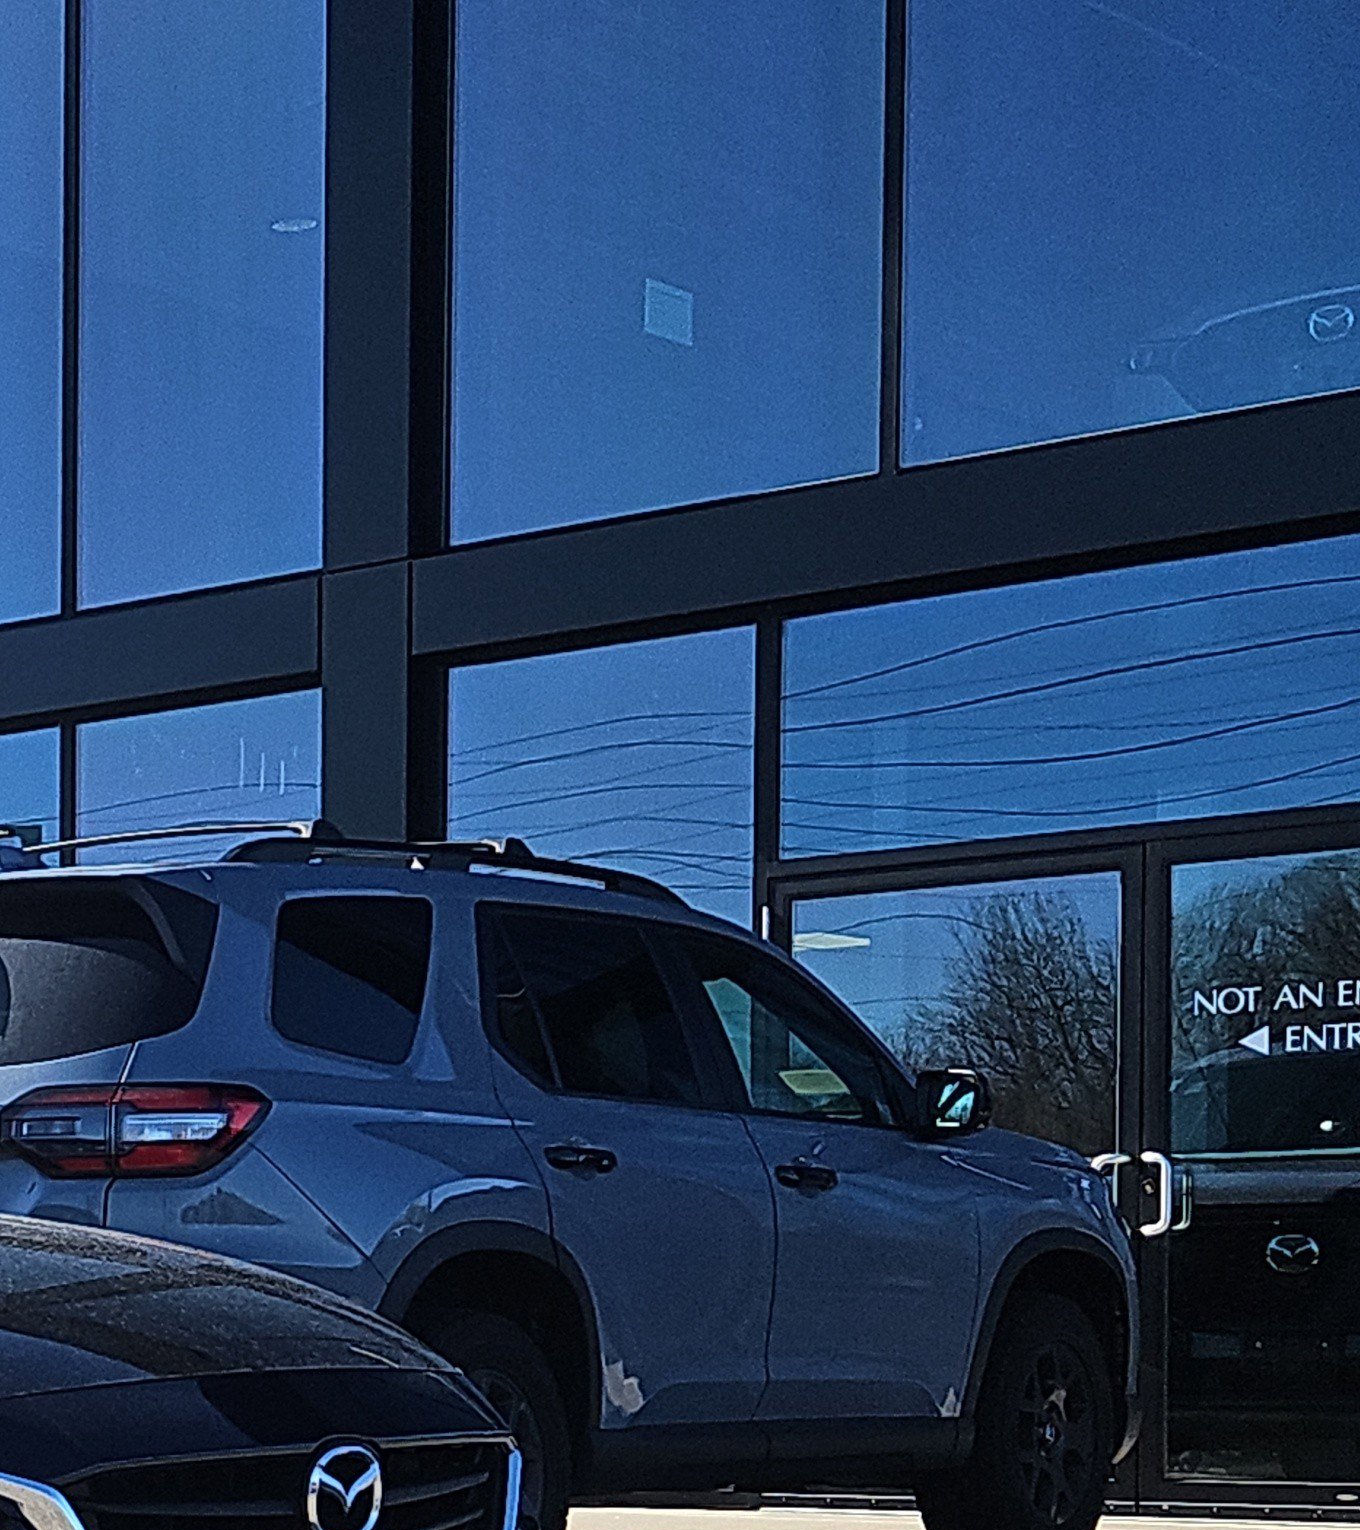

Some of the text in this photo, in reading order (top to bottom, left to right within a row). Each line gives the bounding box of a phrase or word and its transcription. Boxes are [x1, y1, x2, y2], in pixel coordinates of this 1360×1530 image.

[1194, 979, 1360, 1015] NOT AN E
